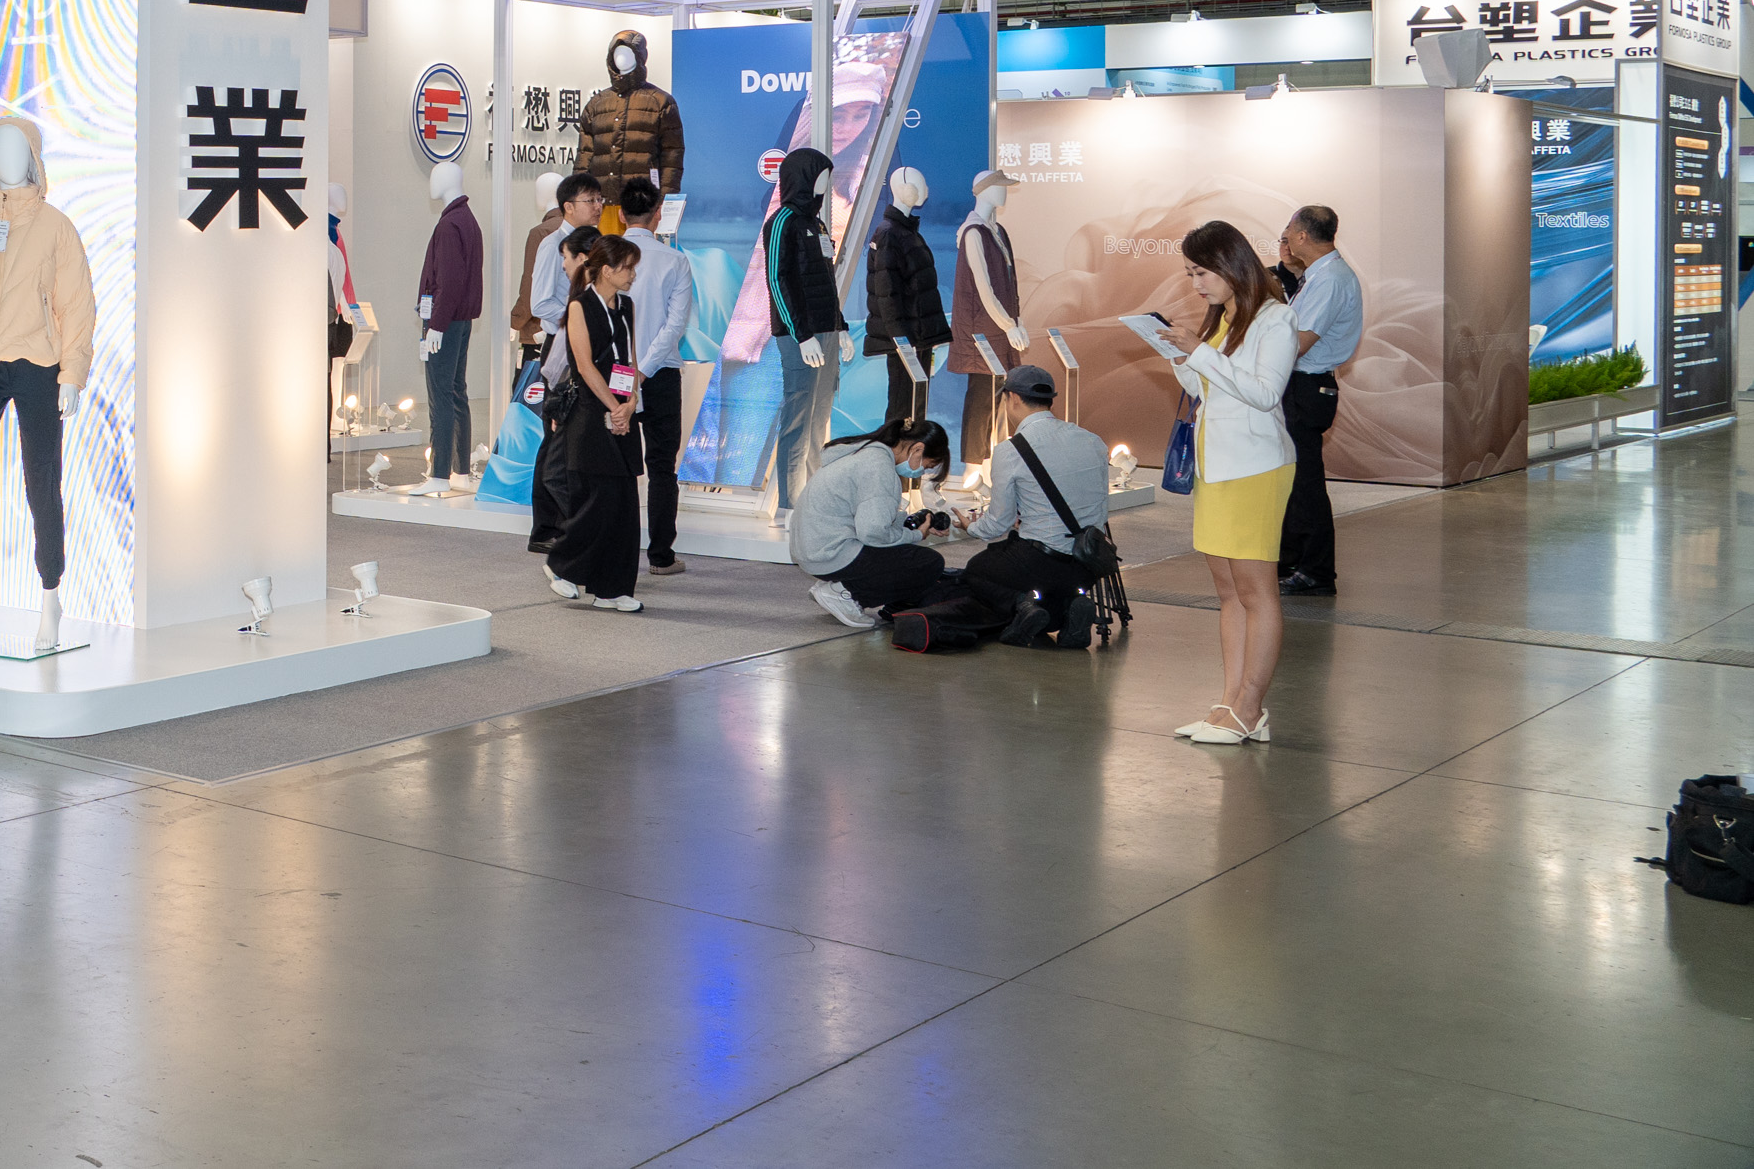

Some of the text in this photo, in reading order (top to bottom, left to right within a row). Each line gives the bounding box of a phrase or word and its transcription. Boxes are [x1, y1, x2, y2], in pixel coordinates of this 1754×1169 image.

[1668, 23, 1732, 50] FORMOSA PLASTICS GROUP
[1513, 47, 1614, 62] PLASTICS
[1625, 46, 1658, 58] GR
[485, 82, 603, 133] 懋興
[1531, 145, 1573, 155] FFETA
[1029, 172, 1084, 183] TAFFETA
[1535, 211, 1610, 228] Textiles
